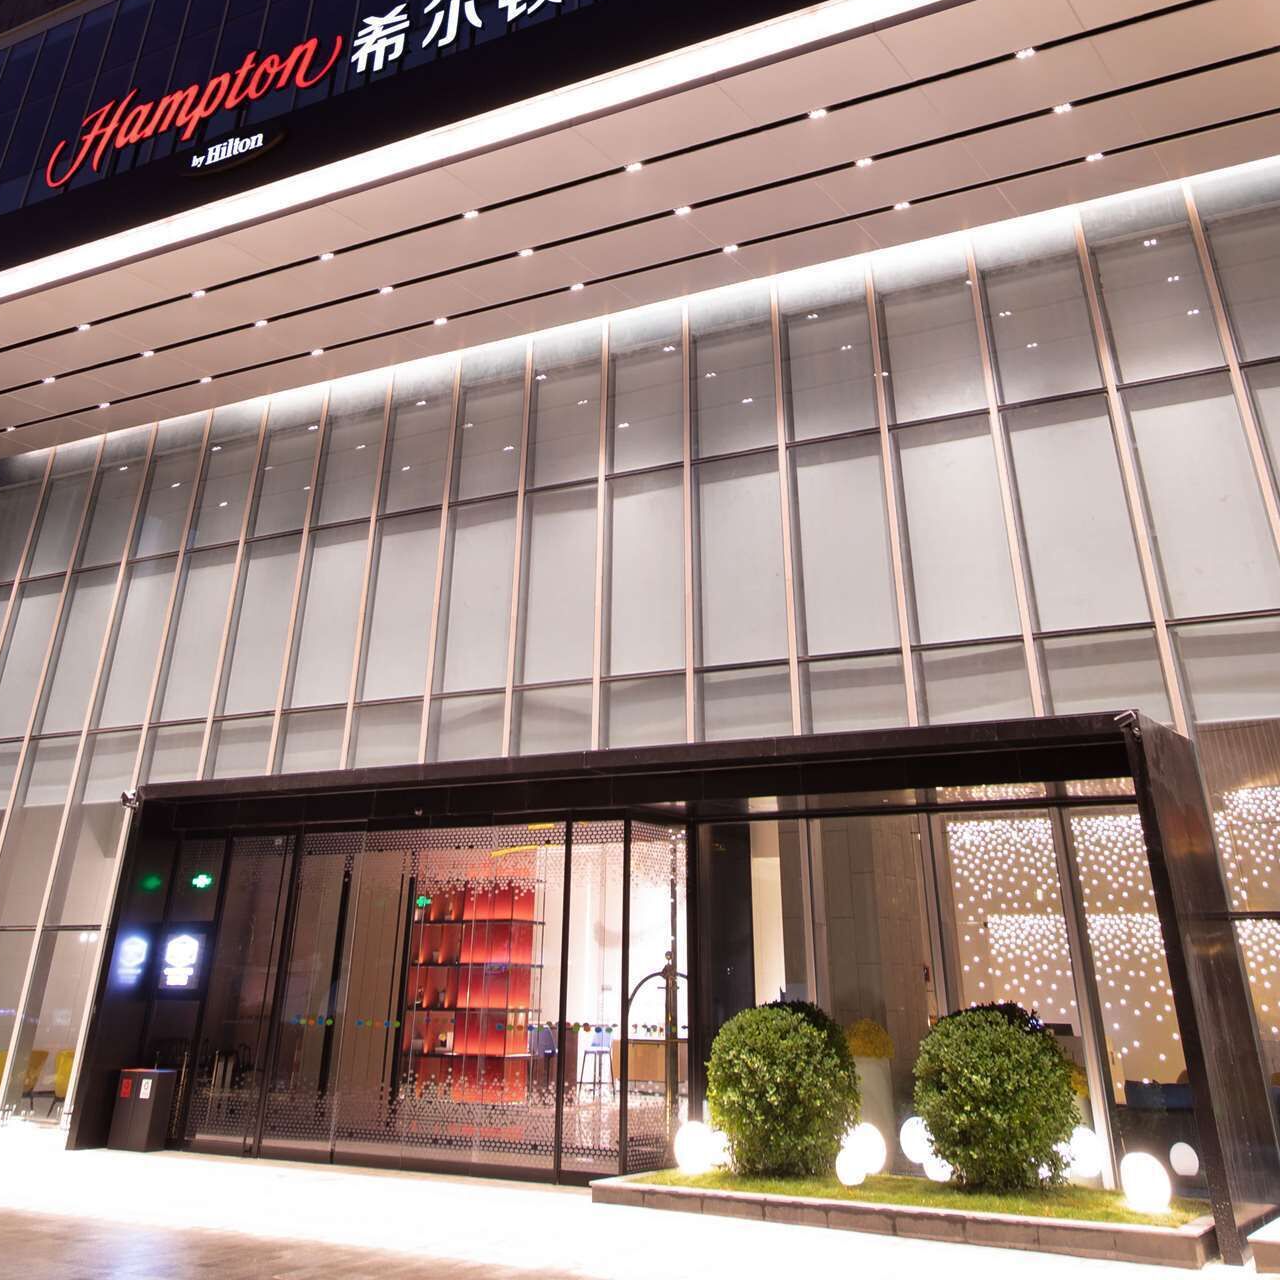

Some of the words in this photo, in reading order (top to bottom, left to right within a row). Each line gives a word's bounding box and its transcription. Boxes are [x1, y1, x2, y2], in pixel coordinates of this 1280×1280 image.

[45, 34, 343, 189] Hampton
[191, 155, 206, 168] by
[205, 133, 264, 166] Hilton
